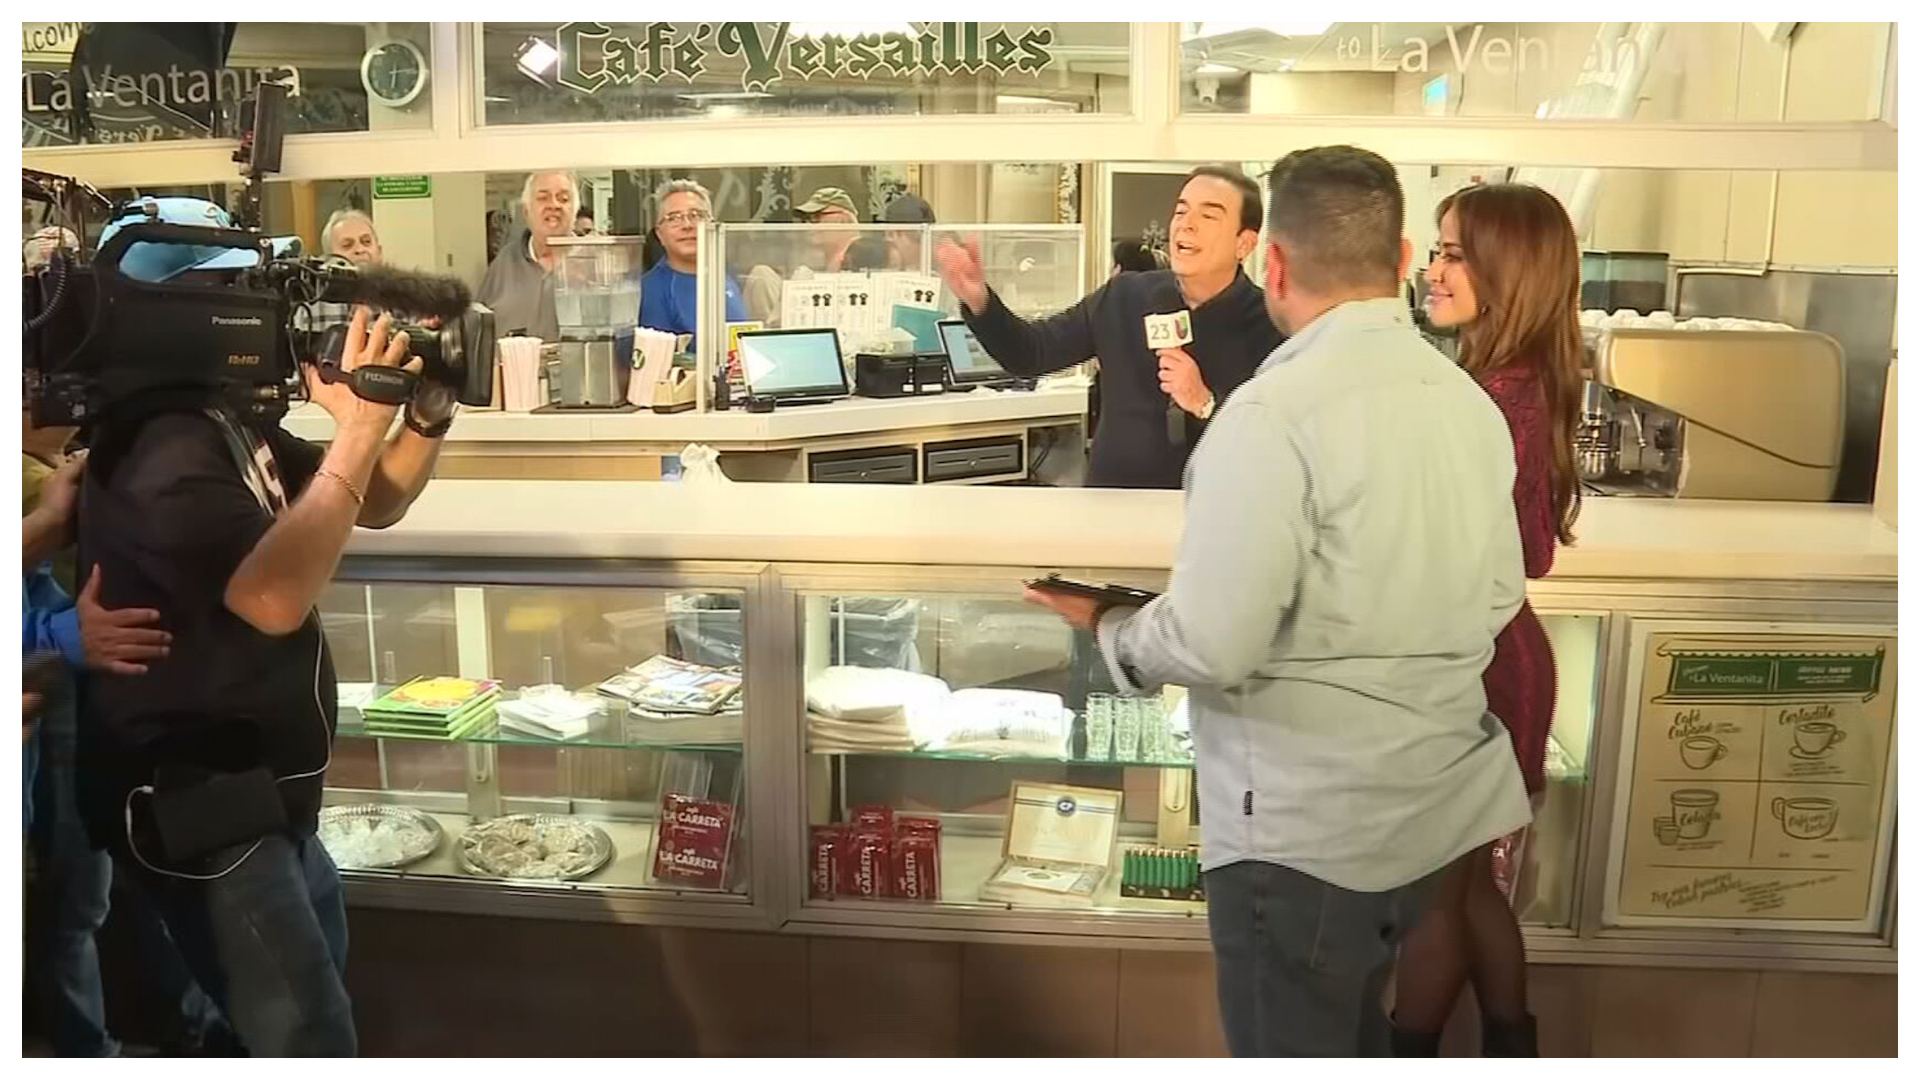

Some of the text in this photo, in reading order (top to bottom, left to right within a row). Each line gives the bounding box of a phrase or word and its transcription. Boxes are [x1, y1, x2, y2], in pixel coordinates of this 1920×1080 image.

[557, 22, 1053, 94] Café Versailles
[1370, 23, 1429, 72] La
[26, 70, 72, 112] La
[212, 316, 262, 326] Panasonic
[1150, 323, 1170, 340] 23
[1708, 673, 1764, 684] Ventanita
[677, 812, 721, 829] CARRETA
[674, 853, 718, 870] CARRETA
[861, 847, 872, 894] CARRETA
[905, 851, 918, 898] CARRETA
